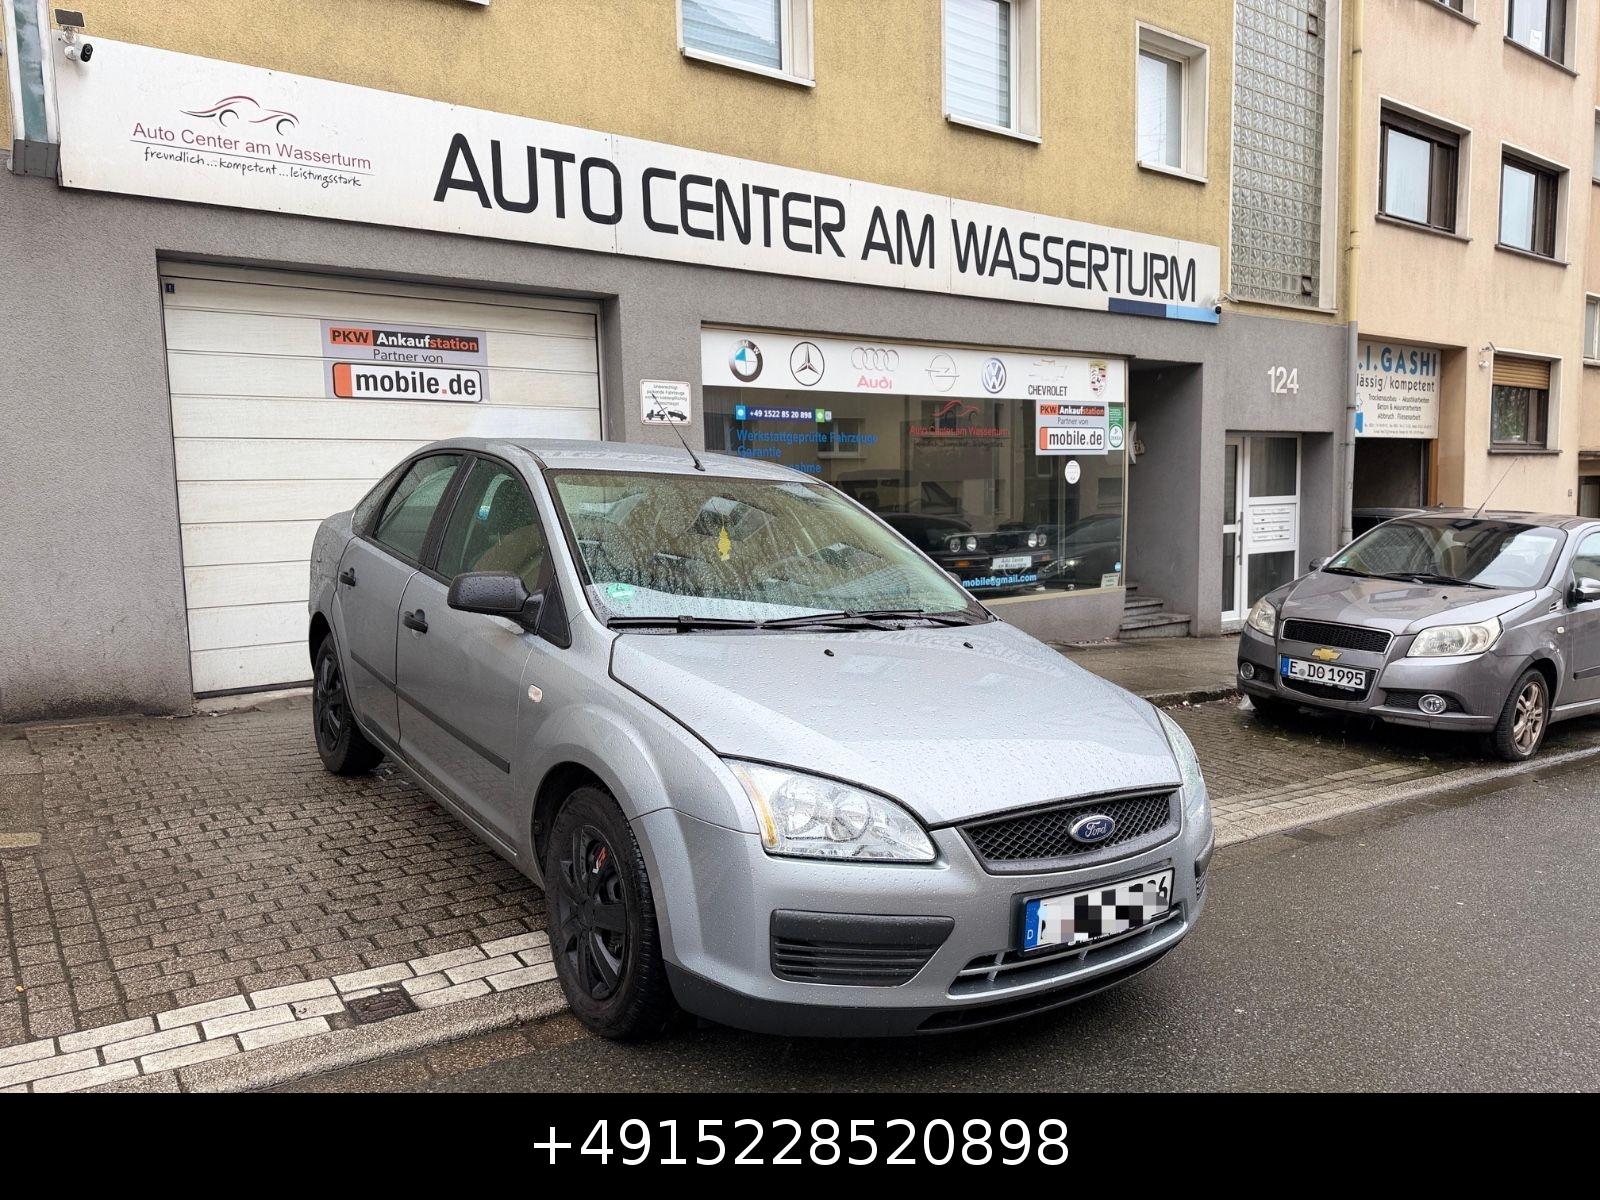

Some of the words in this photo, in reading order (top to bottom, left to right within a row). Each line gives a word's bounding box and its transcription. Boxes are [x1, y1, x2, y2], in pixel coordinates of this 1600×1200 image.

[132, 122, 175, 142] Auto
[181, 128, 240, 151] Center
[245, 140, 271, 156] am
[275, 142, 371, 170] Wasserturm
[432, 132, 624, 226] AUTO
[641, 166, 846, 258] CENTER
[861, 205, 935, 270] AM
[950, 217, 1196, 303] WASSERTURM
[331, 329, 369, 344] PKW
[376, 332, 478, 351] Ankaufstation
[373, 348, 418, 363] Partner
[421, 354, 444, 364] von
[355, 370, 476, 396] mobile.de
[857, 375, 893, 390] Audi
[1267, 366, 1299, 394] 124
[1389, 376, 1435, 393] kompetent
[1027, 384, 1068, 397] CHEVROLET
[749, 409, 763, 418] +49
[763, 410, 780, 418] 1522
[781, 410, 790, 418] 85
[790, 410, 799, 419] 20
[799, 411, 812, 419] 898
[1040, 405, 1057, 414] PKW
[1059, 405, 1104, 415] Ankaufstation
[1057, 416, 1077, 425] Partner
[736, 429, 828, 446] Werkstattgeprüfte
[829, 432, 879, 446] Fahrzeuge
[1049, 430, 1102, 446] mobile.de
[736, 445, 782, 458] Garantie
[1289, 660, 1299, 675] E
[1327, 668, 1364, 686] 1995
[1085, 821, 1107, 838] Ford
[1027, 929, 1033, 940] D
